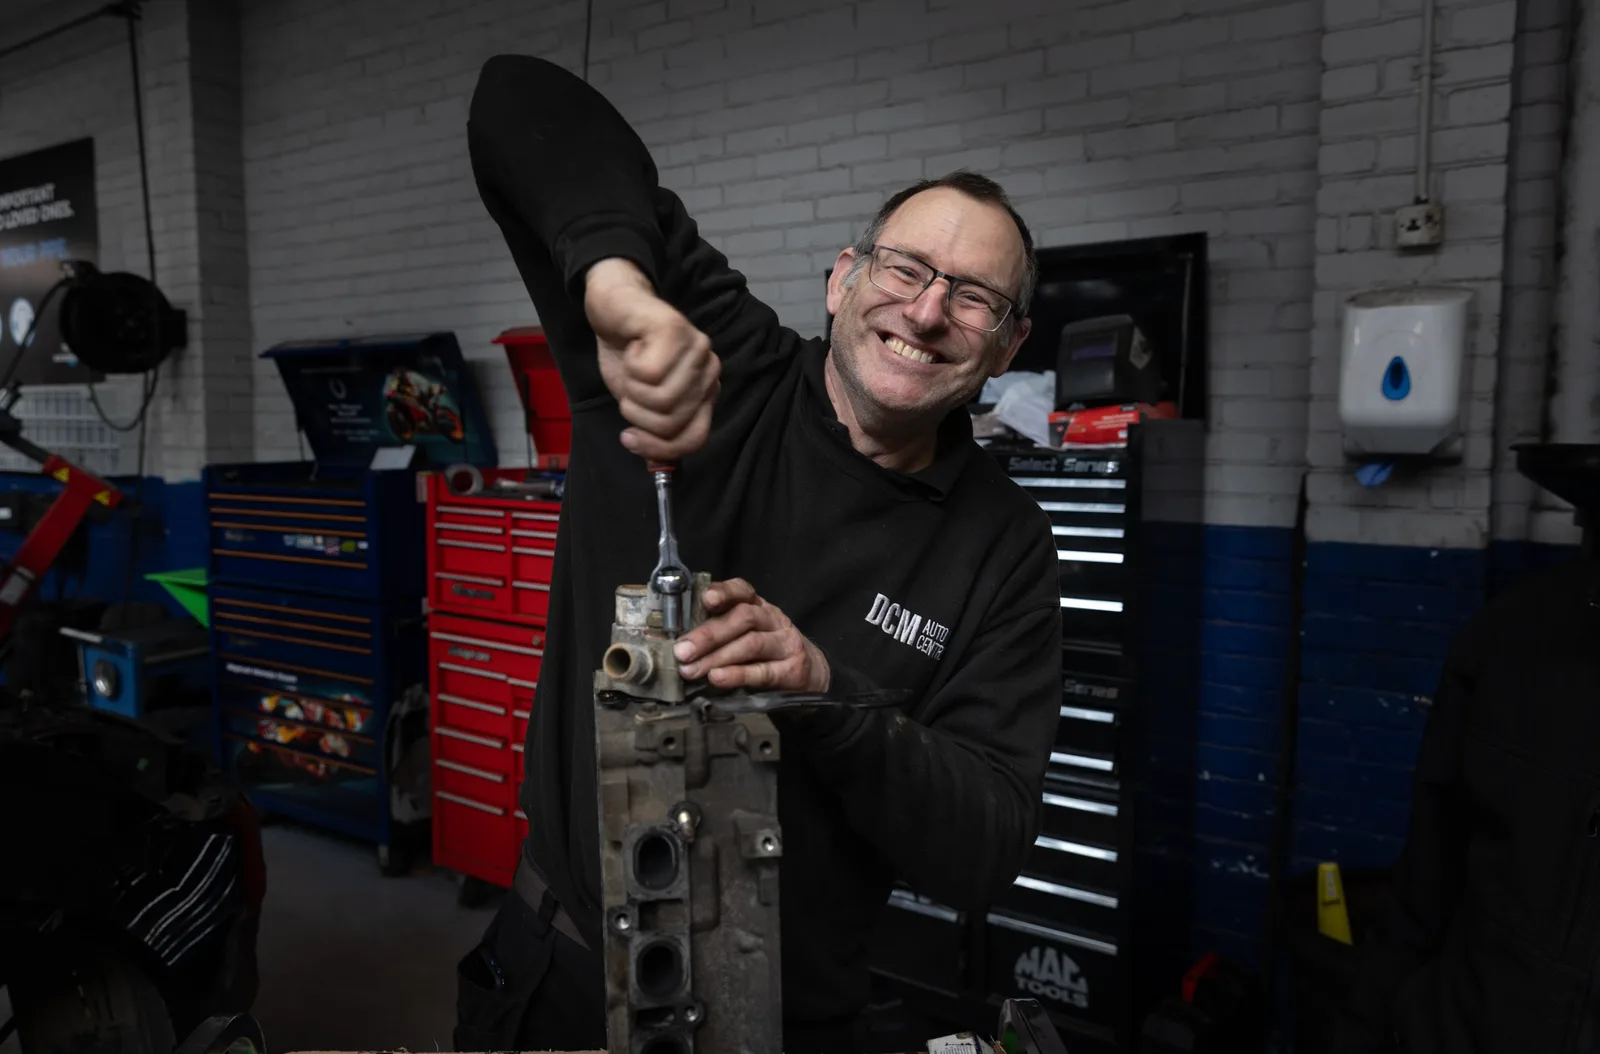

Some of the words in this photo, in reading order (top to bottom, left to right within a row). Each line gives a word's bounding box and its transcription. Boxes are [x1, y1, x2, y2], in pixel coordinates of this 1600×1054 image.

[1008, 457, 1058, 472] Select
[1063, 457, 1120, 474] Series
[864, 592, 922, 646] DCM
[922, 619, 949, 643] AUTO
[1014, 945, 1089, 994] MAC
[1015, 976, 1089, 1009] TOOLS
